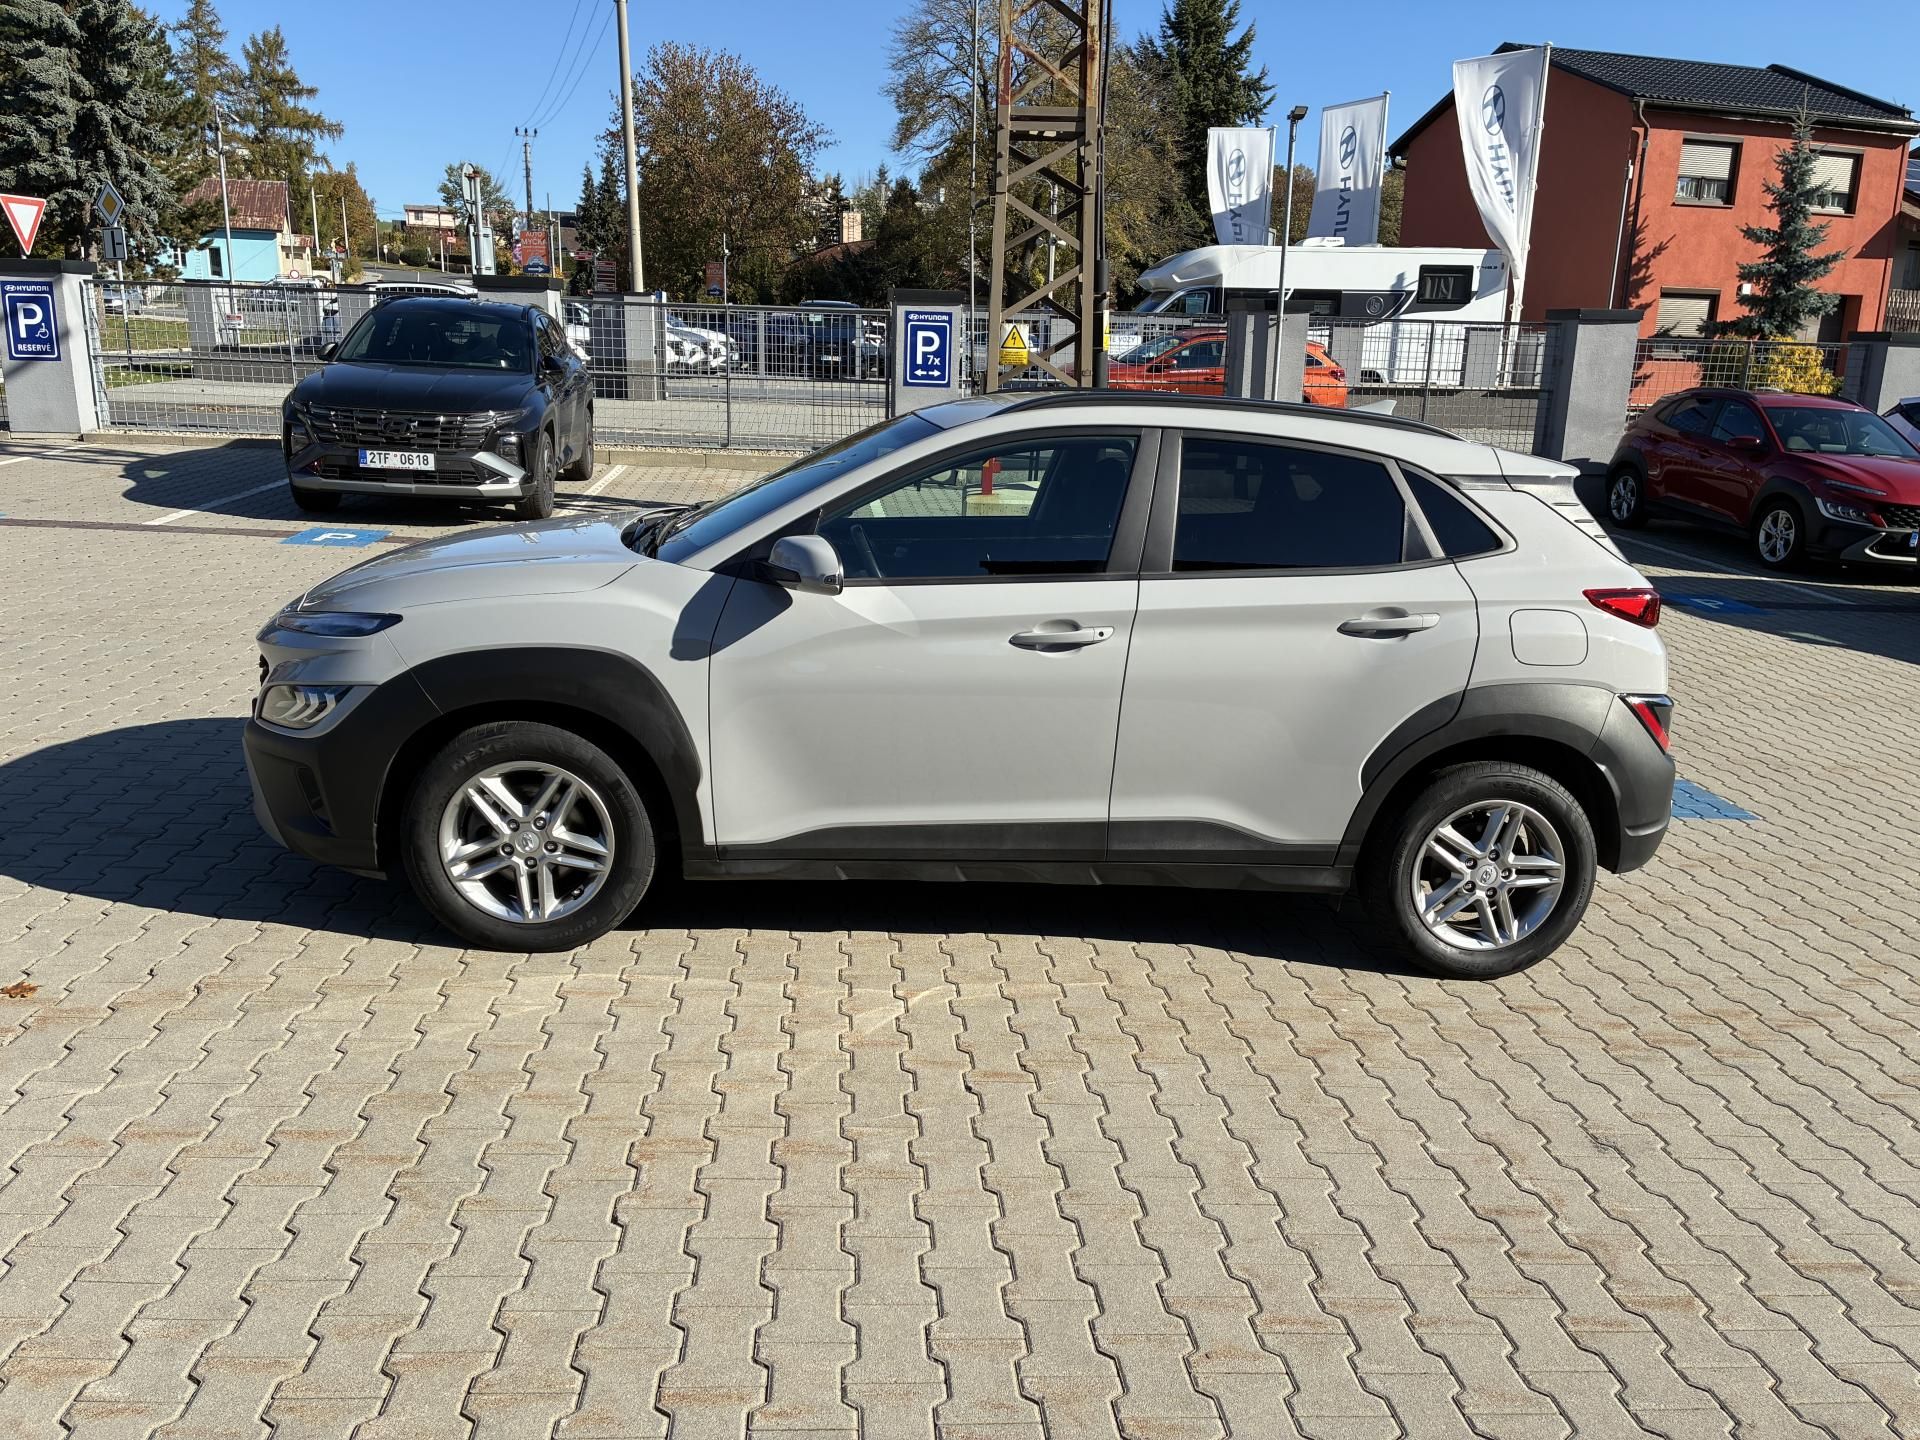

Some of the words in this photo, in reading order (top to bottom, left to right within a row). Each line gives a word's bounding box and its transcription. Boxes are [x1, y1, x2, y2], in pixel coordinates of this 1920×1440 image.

[16, 302, 43, 339] P
[916, 330, 941, 365] P
[926, 354, 941, 366] 7x
[369, 451, 390, 465] 2TF
[400, 453, 429, 466] 0618
